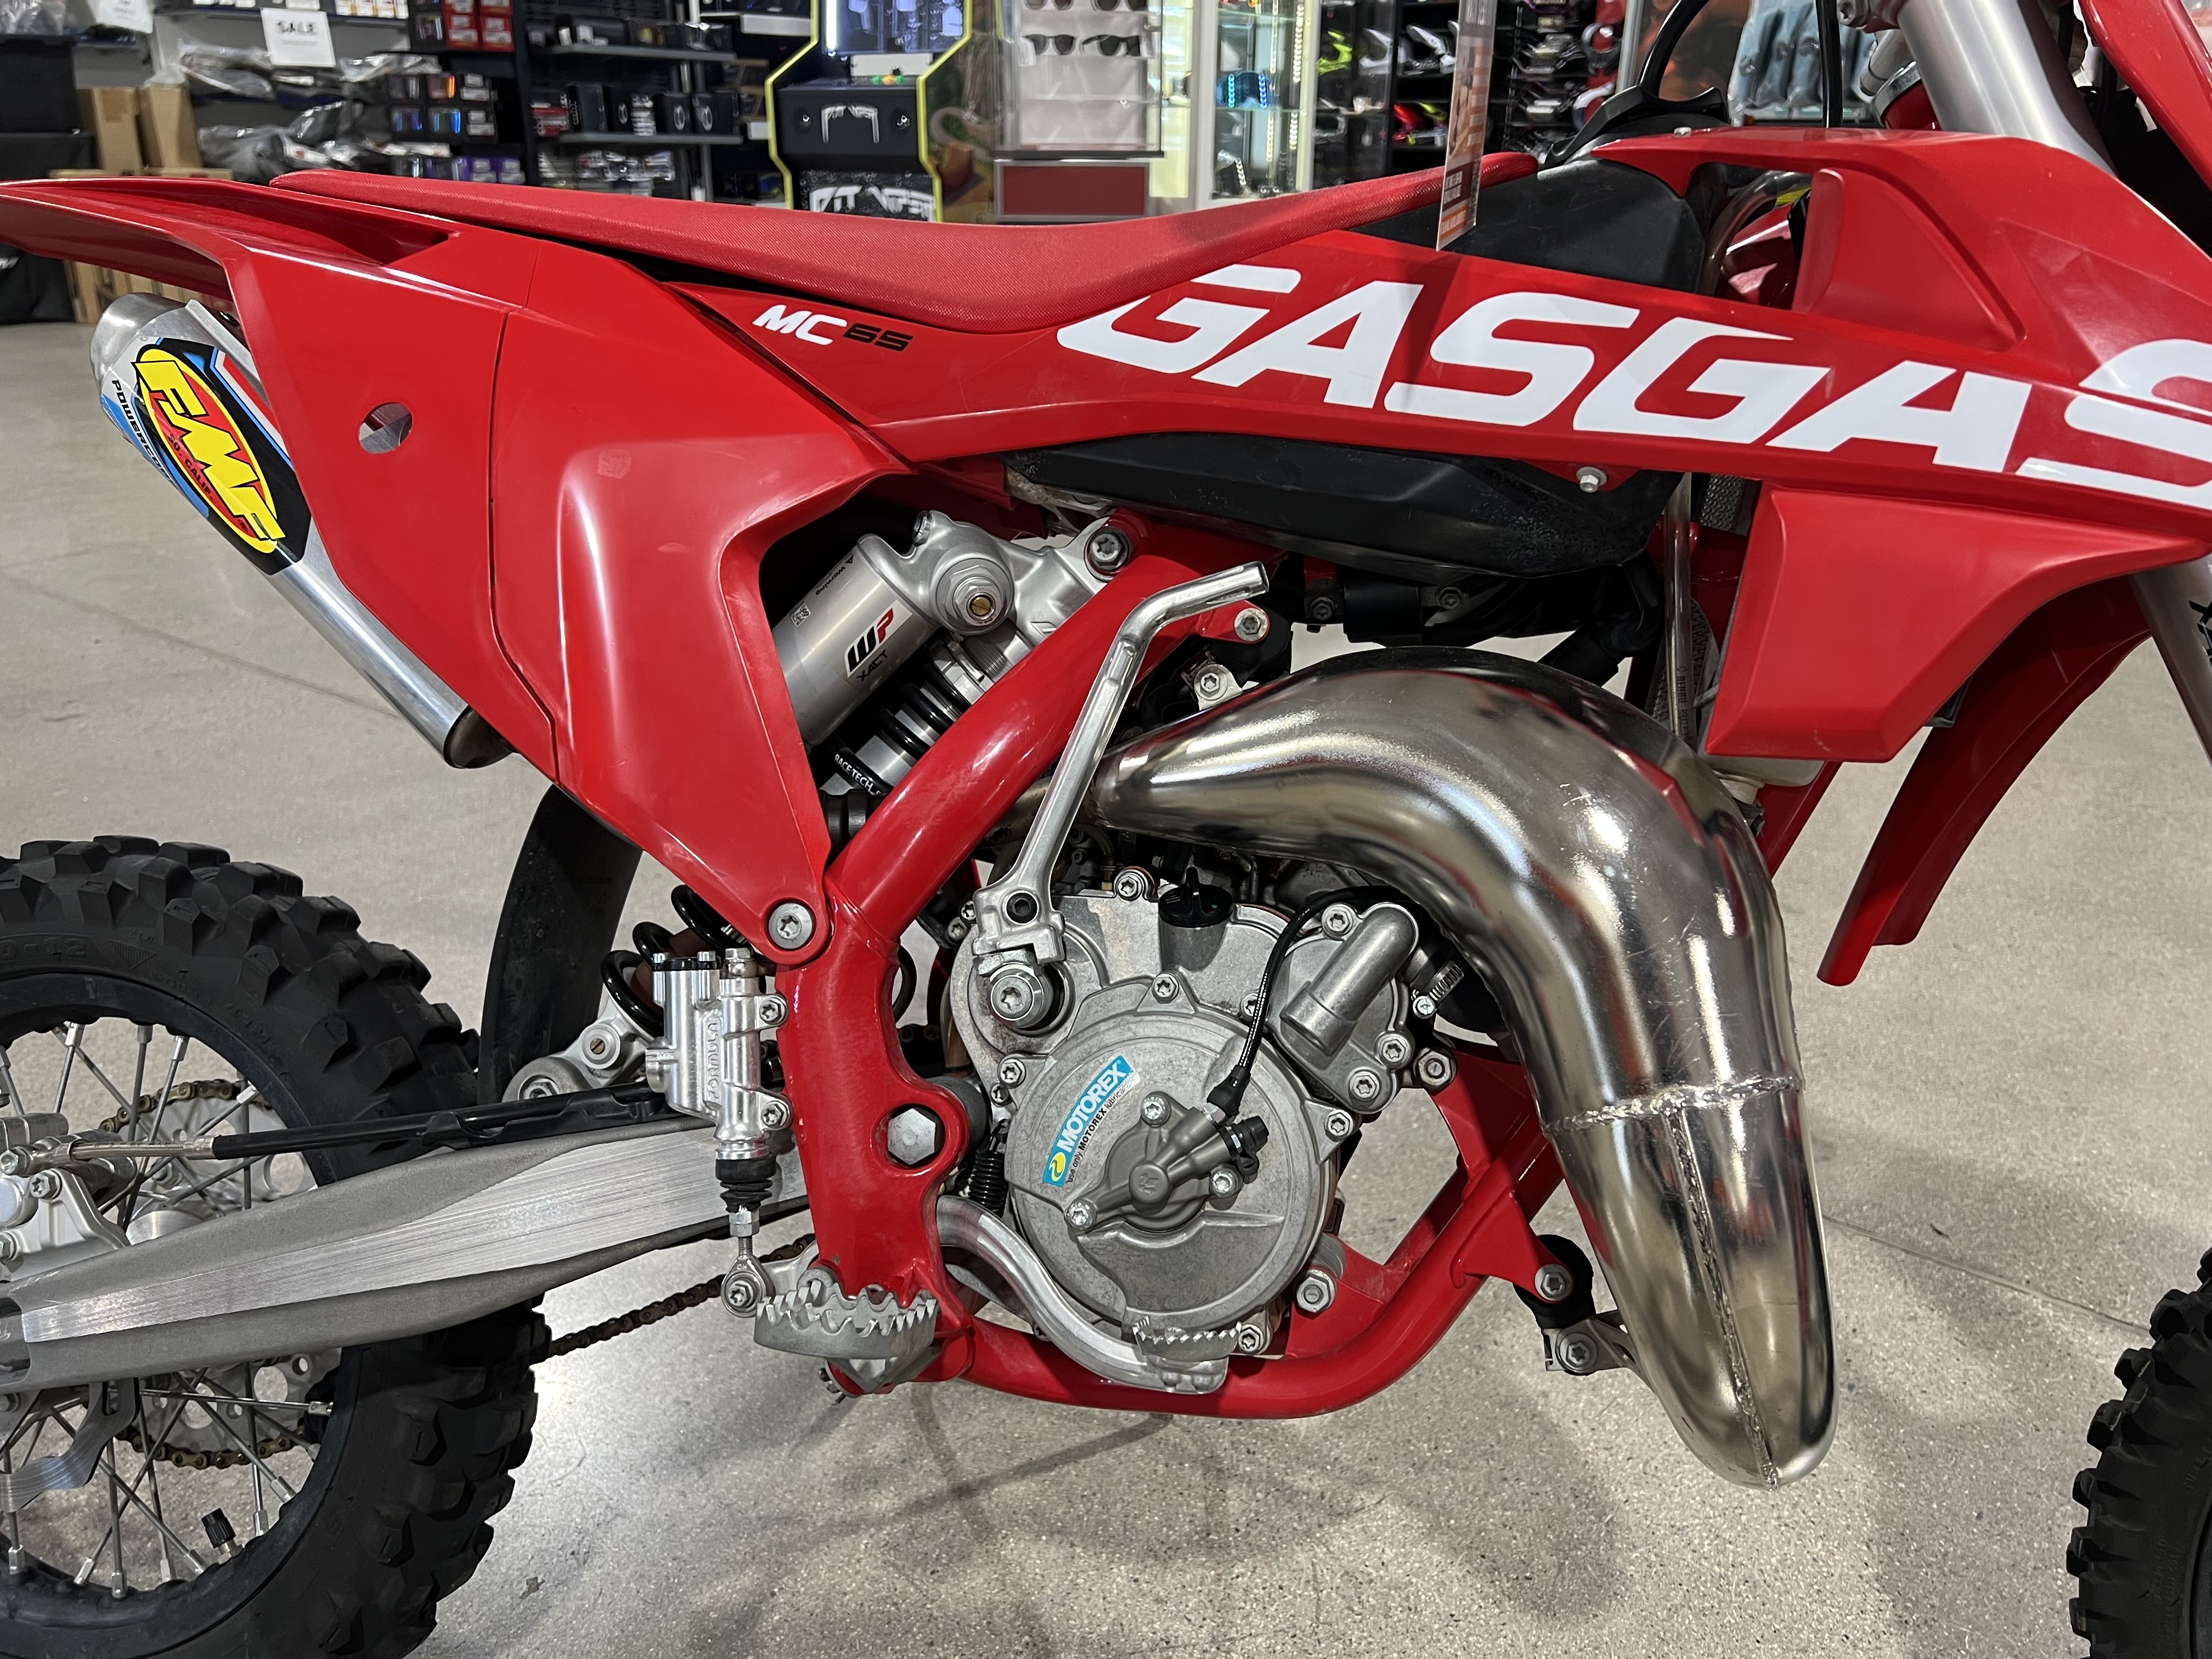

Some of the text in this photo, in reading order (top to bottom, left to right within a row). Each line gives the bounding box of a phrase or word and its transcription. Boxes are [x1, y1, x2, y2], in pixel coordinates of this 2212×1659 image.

[131, 360, 286, 540] FMF
[848, 607, 894, 673] WP
[856, 649, 888, 682] XACT
[707, 1022, 719, 1102] FORMULA
[1057, 1062, 1127, 1153] MOTOREX
[1072, 1152, 1084, 1167] only
[1078, 1108, 1107, 1151] MOTOREX
[1104, 1085, 1128, 1109] lubrica
